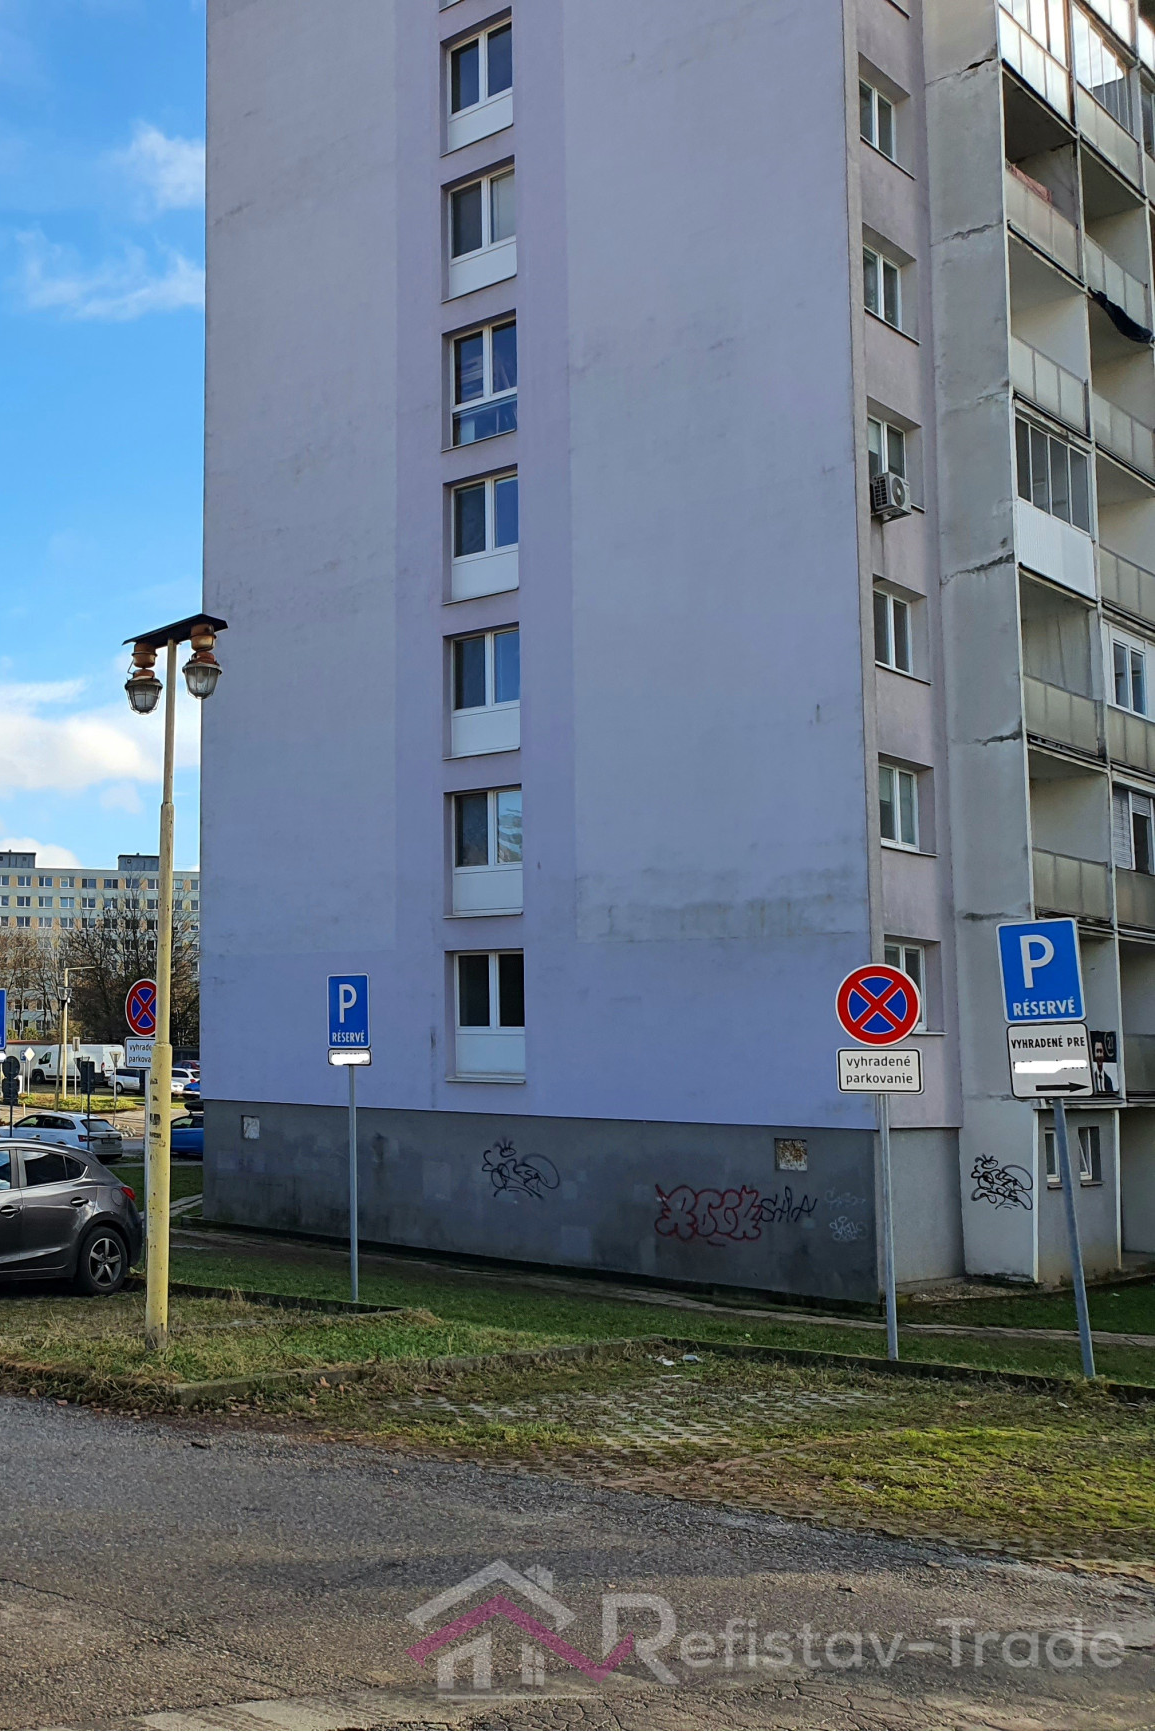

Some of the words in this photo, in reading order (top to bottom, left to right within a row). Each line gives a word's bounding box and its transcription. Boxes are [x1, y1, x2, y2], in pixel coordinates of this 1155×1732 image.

[1019, 934, 1054, 989] P
[338, 983, 357, 1024] P
[1012, 996, 1076, 1017] RÉSERVÉ
[331, 1029, 365, 1043] RÉSERVÉ
[1011, 1035, 1064, 1049] VYHRADENÉ
[1067, 1036, 1086, 1047] PRE
[846, 1055, 911, 1069] vyhradené
[846, 1072, 913, 1086] parkovanie
